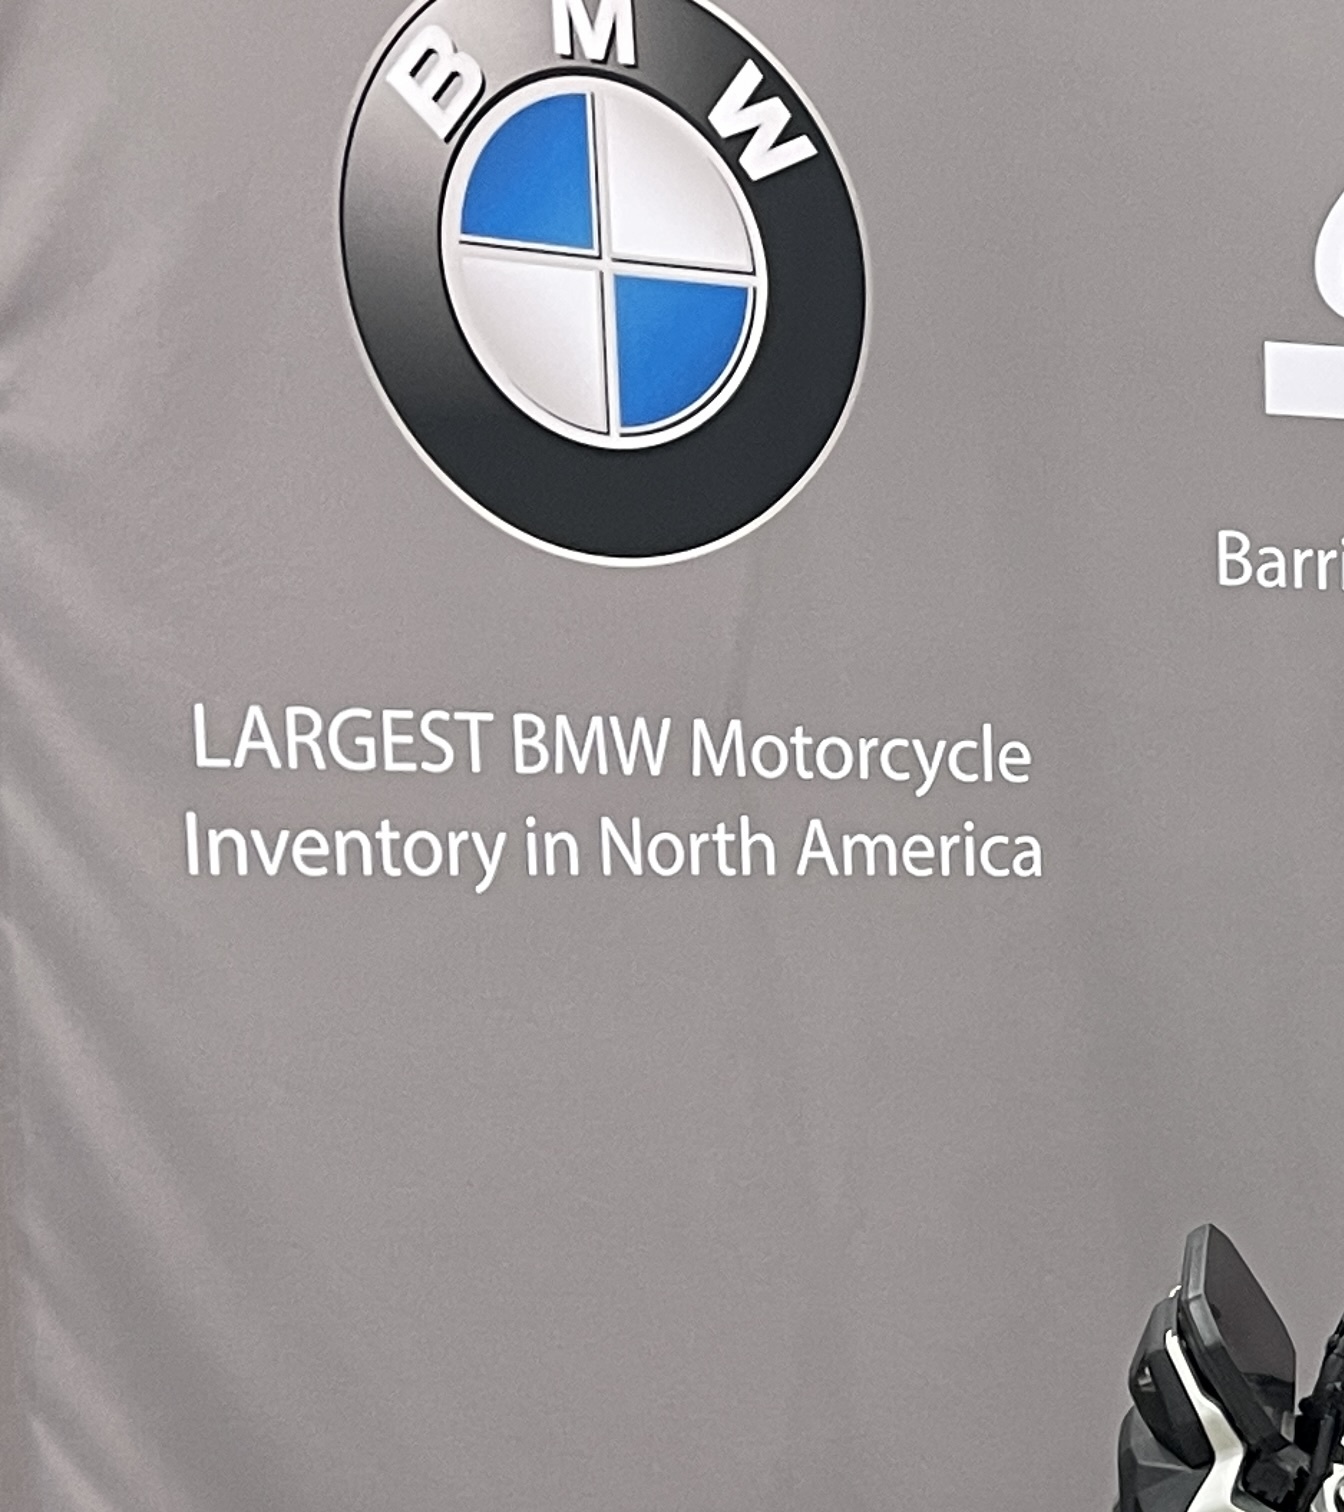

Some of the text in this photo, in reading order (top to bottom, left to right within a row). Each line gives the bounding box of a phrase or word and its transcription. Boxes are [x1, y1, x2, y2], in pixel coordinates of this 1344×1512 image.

[386, 0, 819, 182] BMW
[193, 701, 1033, 799] LARGEST BMW Motorcycle
[184, 810, 1043, 895] Inventory in North America
